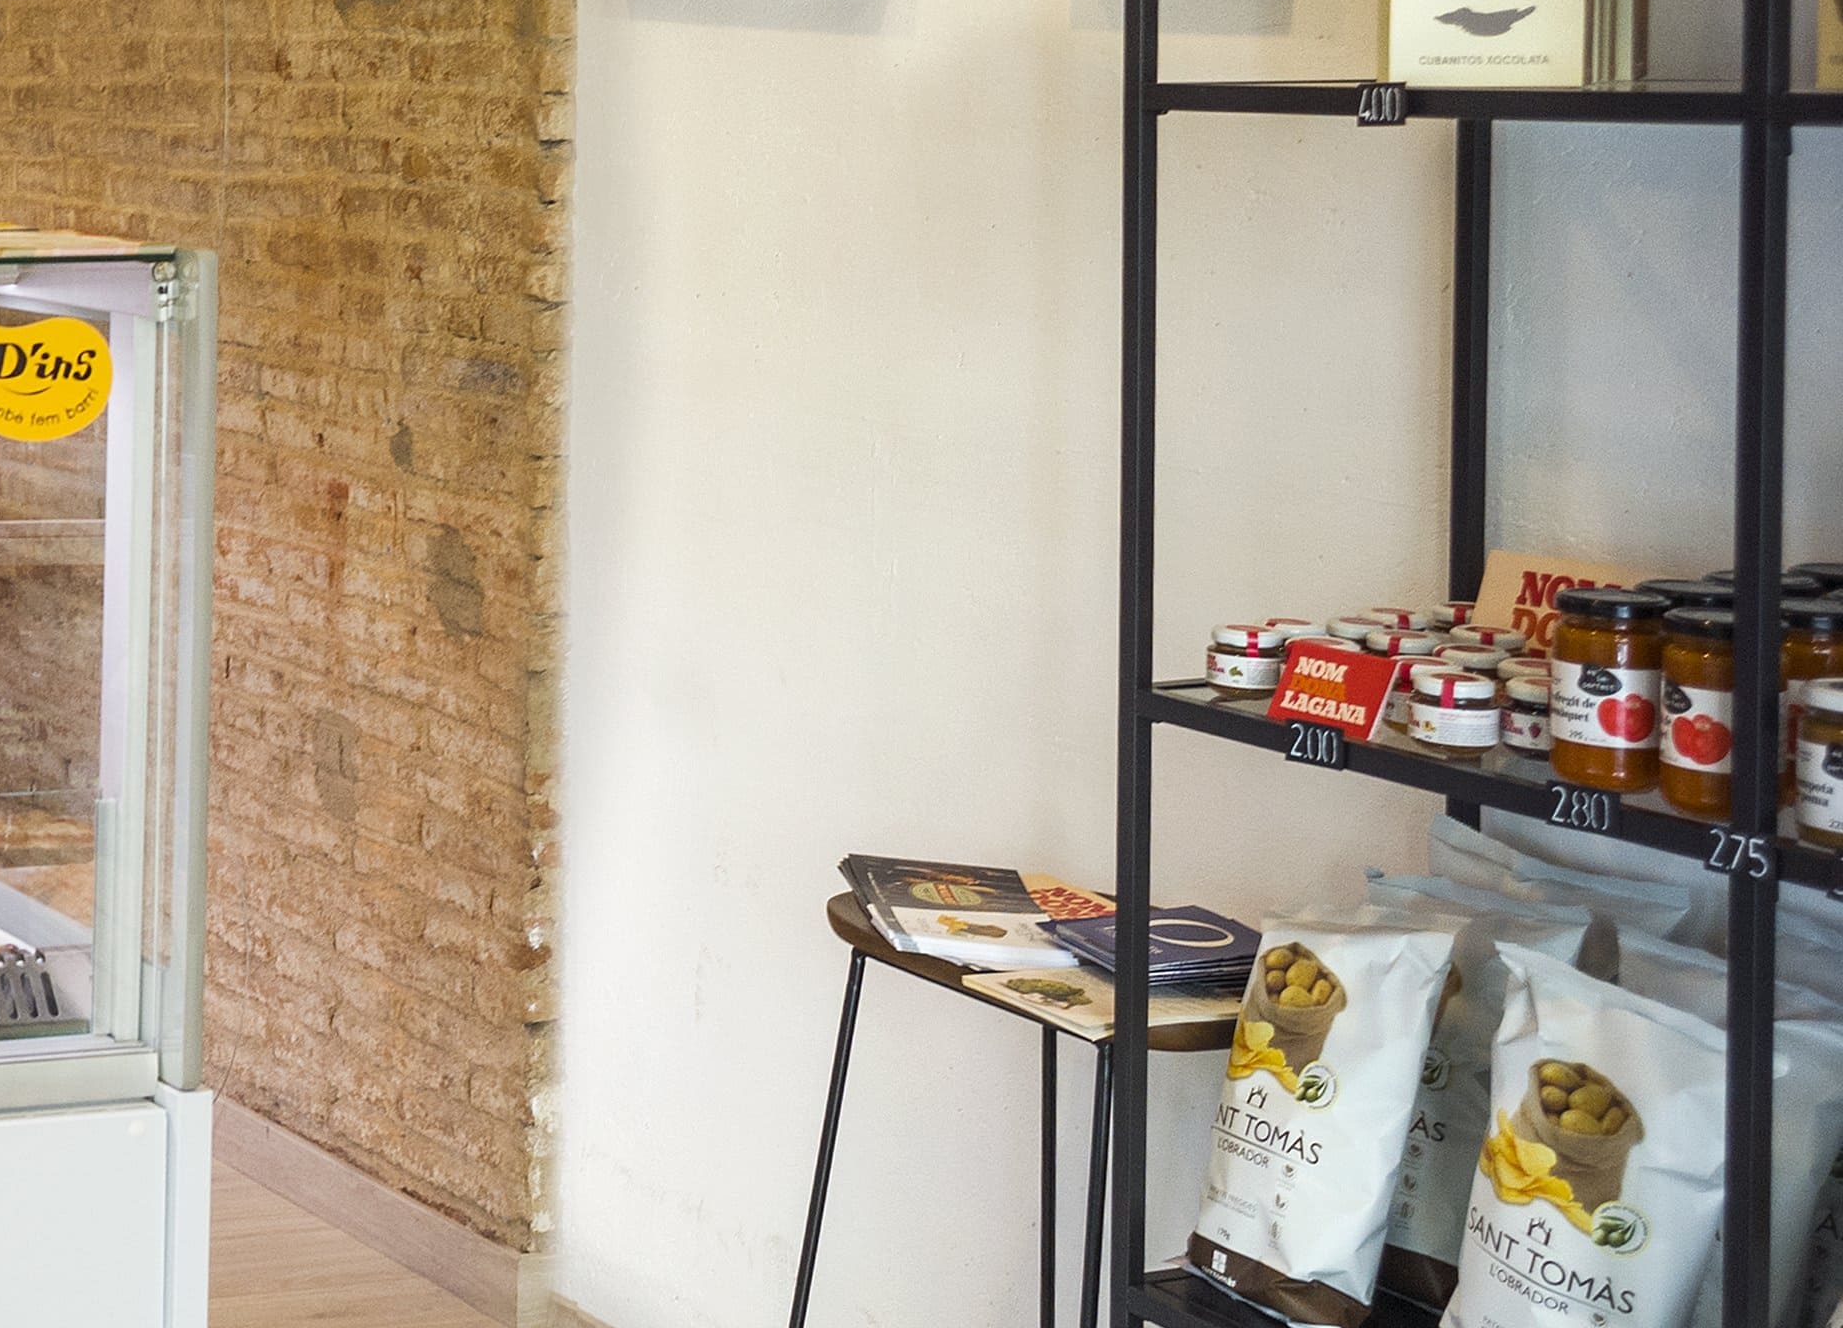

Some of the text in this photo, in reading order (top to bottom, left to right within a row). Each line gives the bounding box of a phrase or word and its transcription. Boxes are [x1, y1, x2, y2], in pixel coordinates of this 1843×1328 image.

[1512, 608, 1561, 648] DO
[1289, 675, 1347, 701] DONA
[1294, 656, 1349, 683] NOM
[1280, 690, 1365, 726] LAGANA
[1290, 722, 1339, 765] 2.00
[1551, 786, 1611, 831] 2.80
[1709, 828, 1768, 878] 2.75
[1245, 1114, 1322, 1165] TOMÀS
[1467, 1206, 1636, 1314] SANT TOMÀS
[1489, 1263, 1568, 1315] L'OBRADOR
